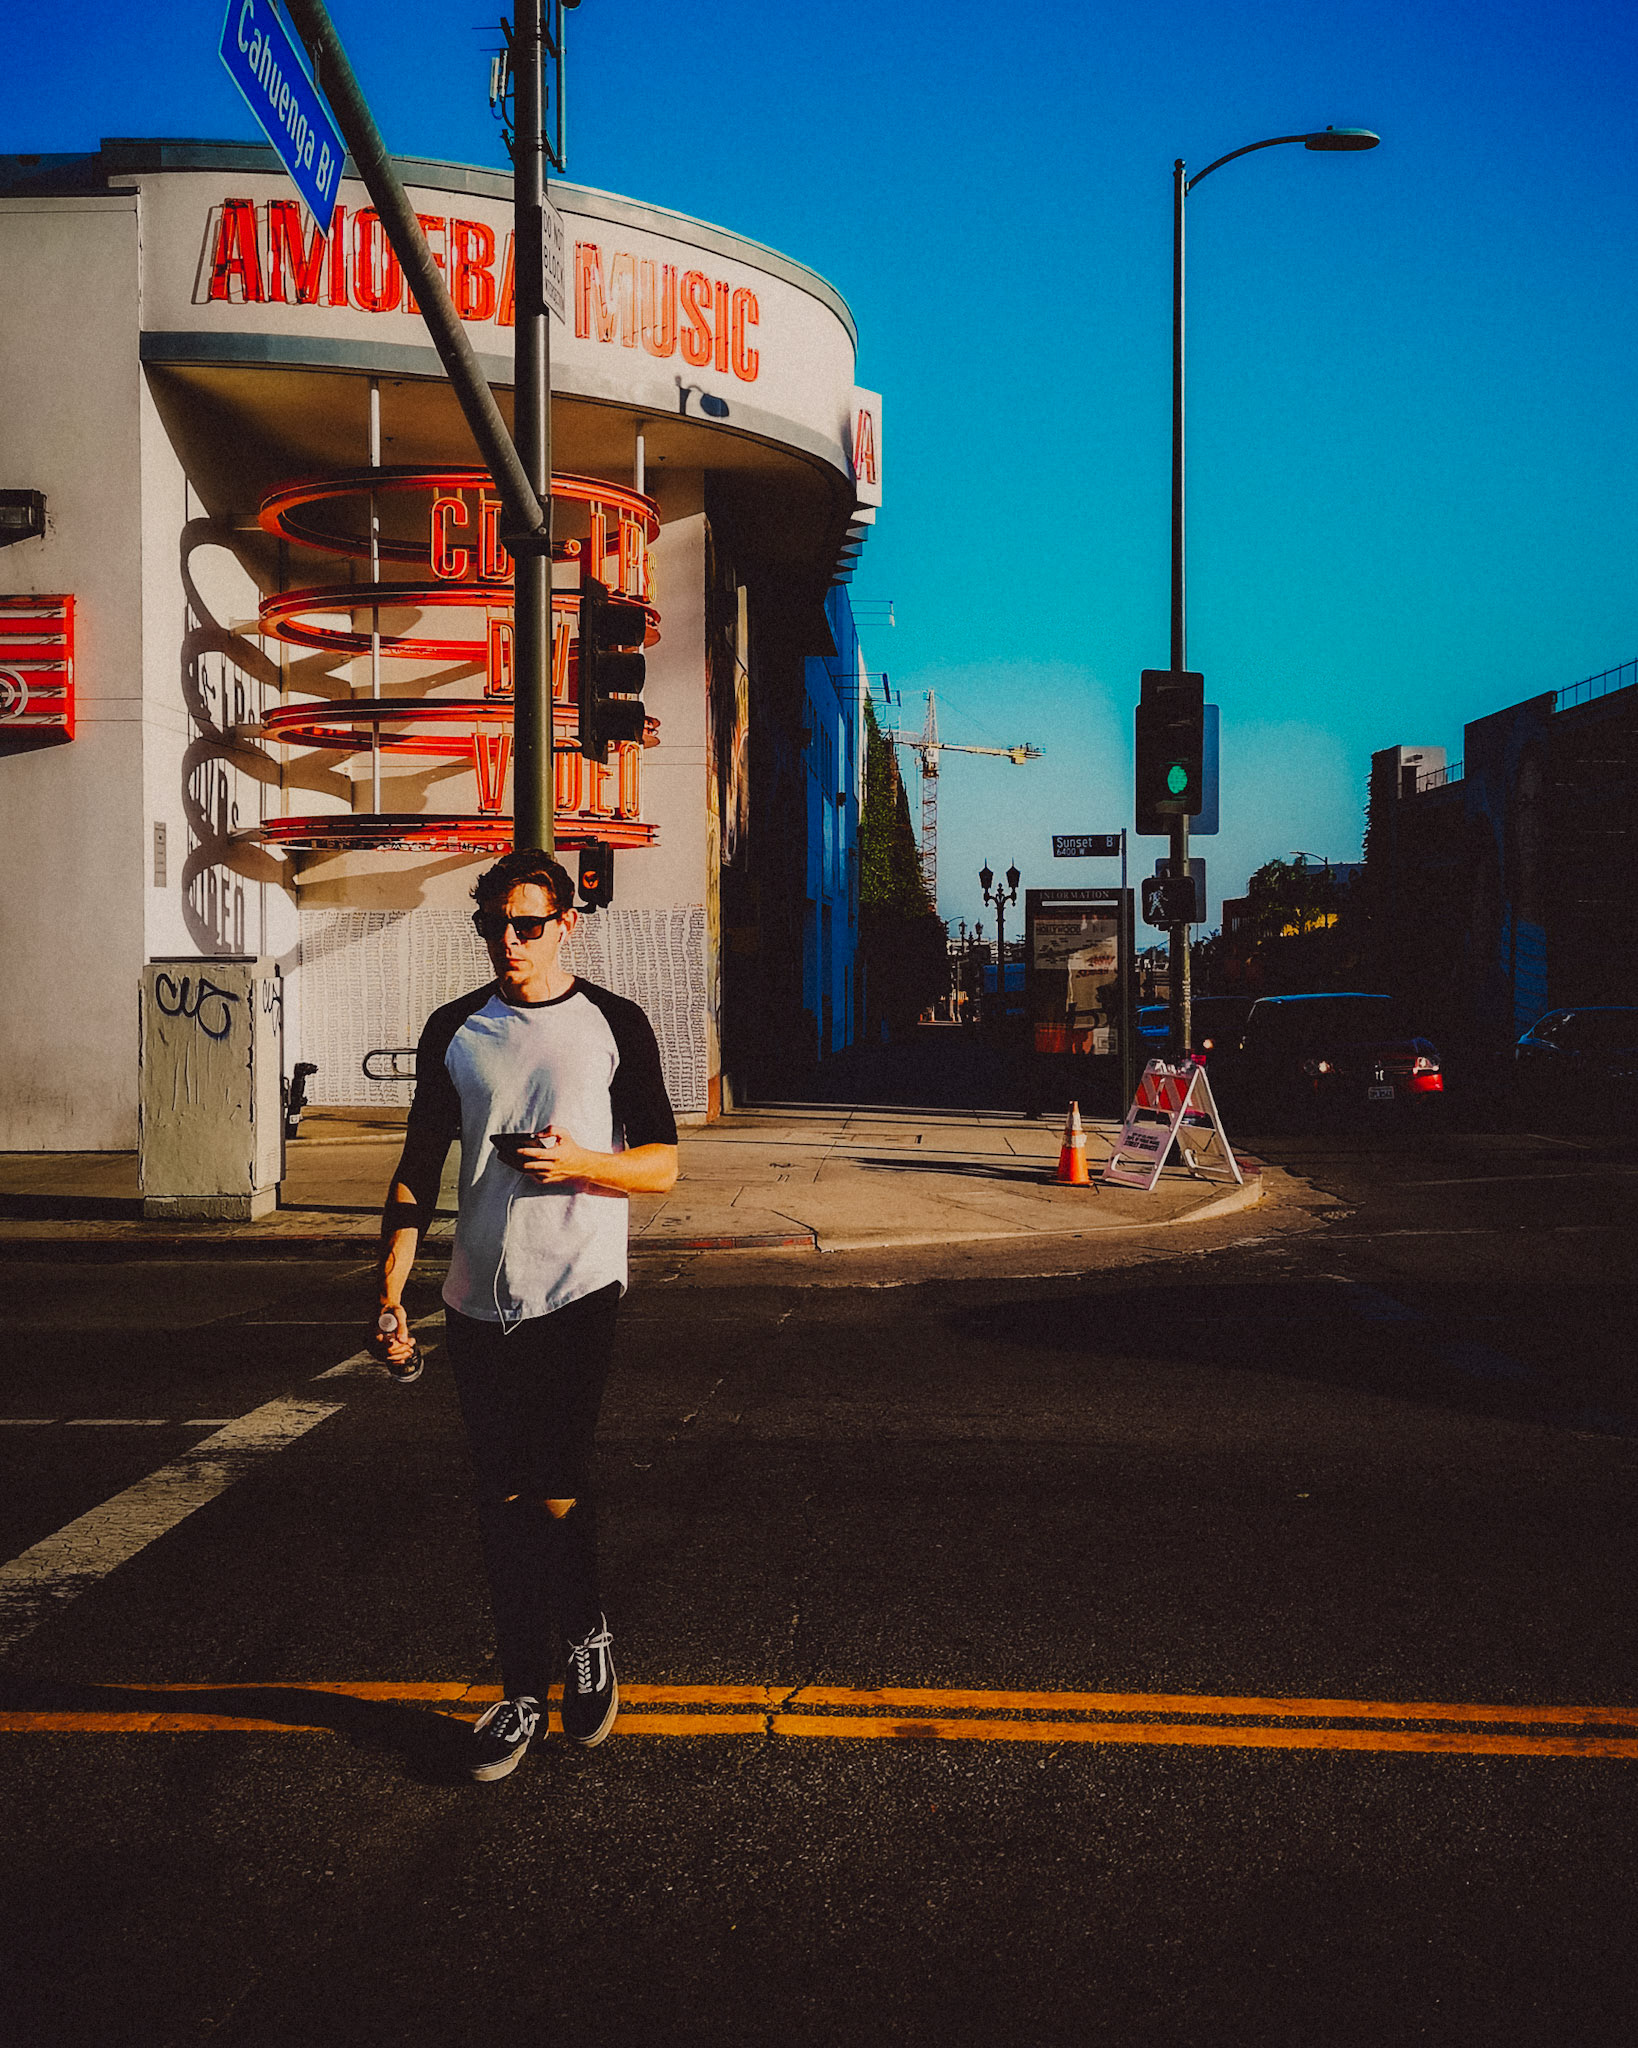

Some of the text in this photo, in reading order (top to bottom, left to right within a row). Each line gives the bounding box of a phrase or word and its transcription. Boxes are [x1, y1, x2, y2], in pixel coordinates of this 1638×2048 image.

[237, 0, 335, 202] Cahuenga Bl
[543, 208, 552, 239] DO
[575, 240, 760, 383] MUSIC
[471, 732, 642, 819] VDEO
[1056, 837, 1093, 848] Sunset
[1056, 848, 1077, 856] 6400
